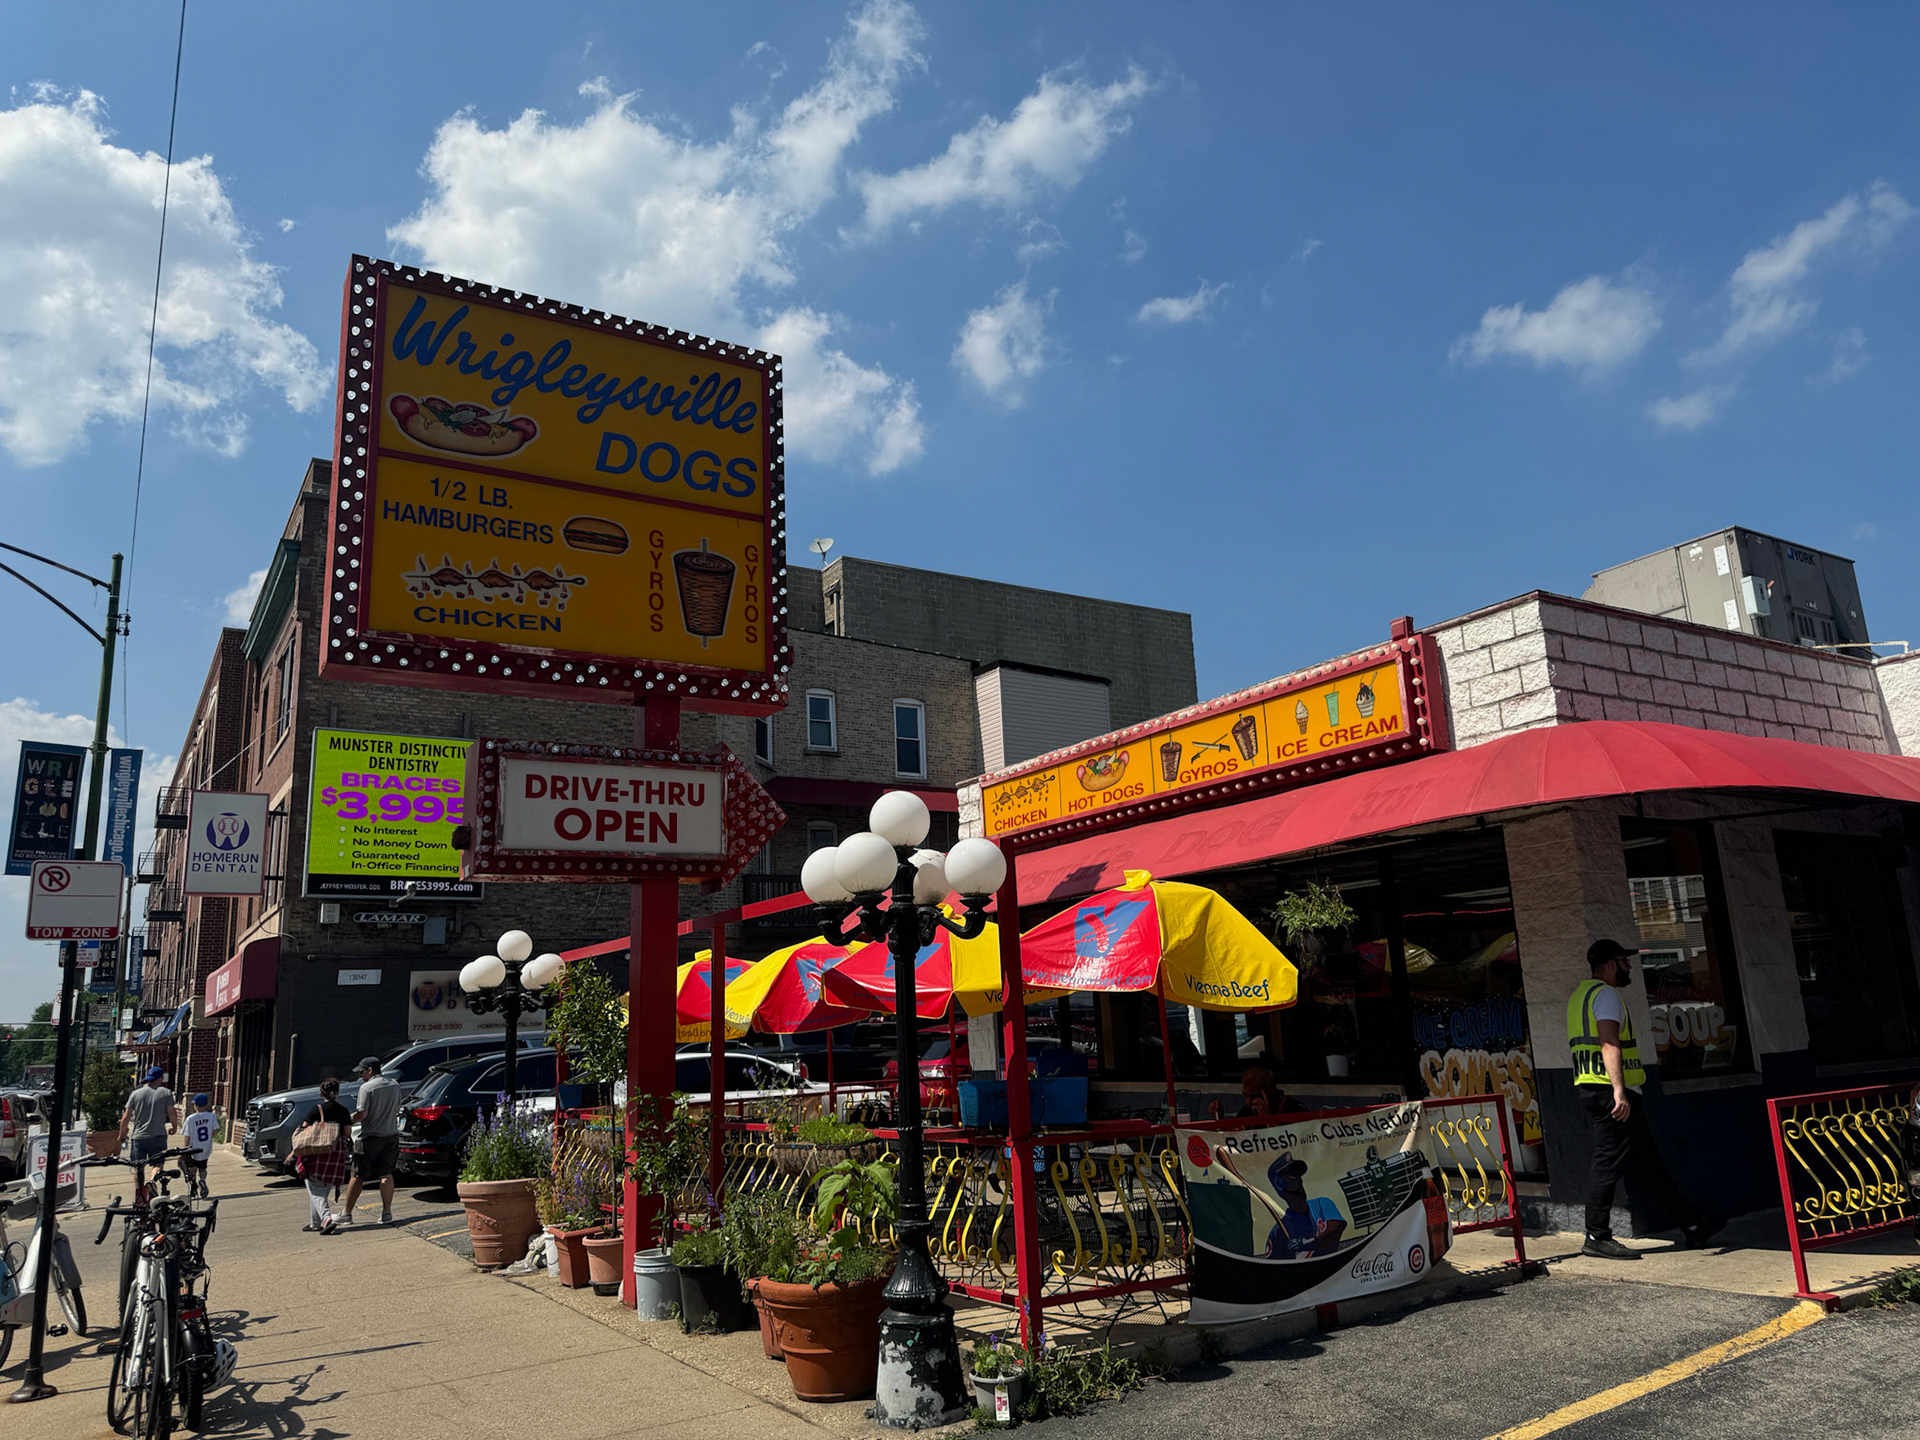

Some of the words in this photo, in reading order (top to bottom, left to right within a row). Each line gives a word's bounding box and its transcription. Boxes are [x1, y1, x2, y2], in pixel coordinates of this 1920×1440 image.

[392, 294, 758, 435] Wrigleysville
[595, 431, 758, 498] DOGS
[429, 476, 467, 503] 1/2
[479, 484, 514, 511] LB.
[383, 500, 555, 545] HAMBURGERS
[1793, 550, 1816, 567] YORK
[648, 530, 665, 634] GYROS
[743, 544, 760, 645] GYROS
[413, 604, 562, 634] CHICKEN
[329, 736, 393, 755] MUNSTER
[399, 742, 467, 759] DISTINCTIV
[1276, 737, 1309, 761] ICE
[1319, 714, 1399, 749] CREAM
[368, 756, 440, 774] DENTISTRY
[1179, 756, 1239, 785] GYROS
[340, 772, 461, 794] BRACES
[524, 773, 706, 808] DRIVE-THRU
[1068, 793, 1096, 813] HOT
[1102, 781, 1145, 805] DOGS
[108, 755, 136, 863] wrigleyvillechicago.o
[993, 806, 1048, 832] CHICKEN
[353, 825, 371, 834] No
[373, 826, 418, 837] Interest
[553, 807, 678, 845] OPEN
[192, 851, 259, 864] HOMERUN
[352, 838, 370, 847] No
[373, 839, 411, 849] Money
[414, 840, 448, 850] Down
[352, 850, 420, 861] Guaranteed
[191, 862, 258, 874] DENTAL
[351, 860, 402, 871] In-Office
[405, 863, 460, 874] Financing
[390, 880, 473, 892] BRAES3995.com
[33, 927, 65, 938] TOW
[71, 927, 111, 938] ZONE
[359, 914, 421, 923] LAMAR
[1183, 971, 1230, 999] Vienna
[1231, 979, 1269, 1001] Beef
[1411, 1009, 1448, 1050] ICE
[1449, 999, 1523, 1049] CREAM
[1650, 1005, 1725, 1051] SOUP
[1419, 1047, 1533, 1113] CONES
[197, 1126, 209, 1142] 8
[1226, 1130, 1298, 1154] Refresh
[1300, 1133, 1319, 1146] with
[1320, 1120, 1364, 1140] Cubs
[1366, 1105, 1420, 1133] Nation
